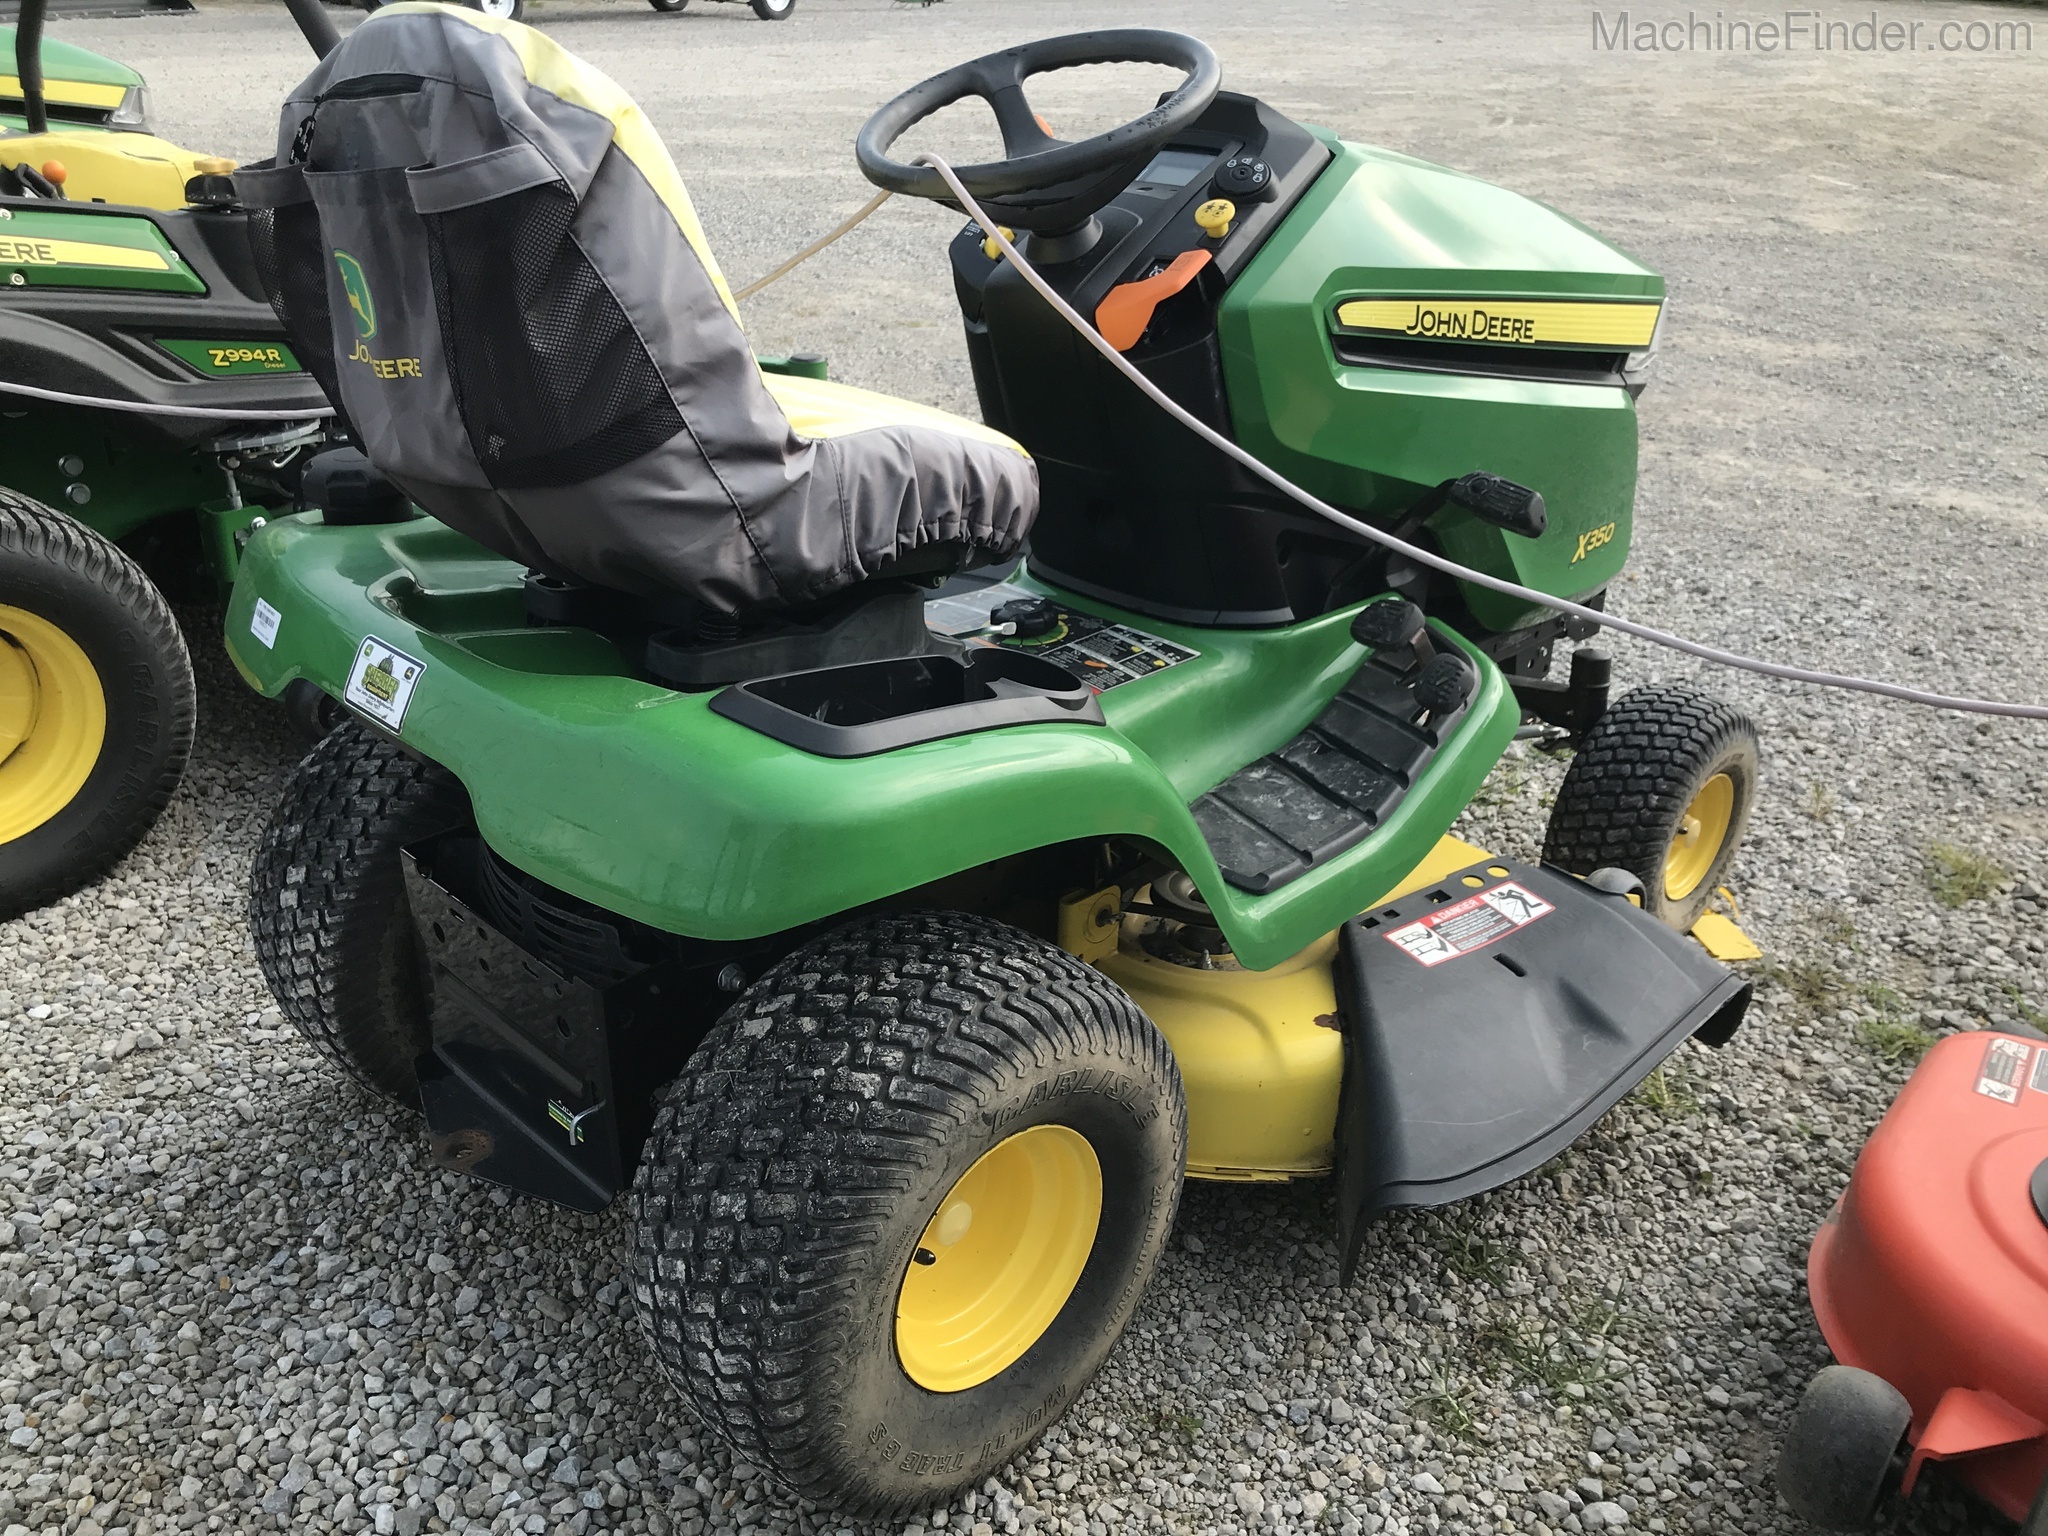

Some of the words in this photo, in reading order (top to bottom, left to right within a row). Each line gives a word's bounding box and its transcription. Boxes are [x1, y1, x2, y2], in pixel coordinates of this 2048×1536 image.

[1406, 304, 1467, 335] JOHN
[1471, 310, 1535, 339] DEERE
[207, 348, 282, 367] Z994R
[1571, 522, 1615, 564] X350
[1438, 899, 1481, 919] DANGER
[992, 1067, 1160, 1135] CARLISLE
[900, 1450, 966, 1477] TRAC
